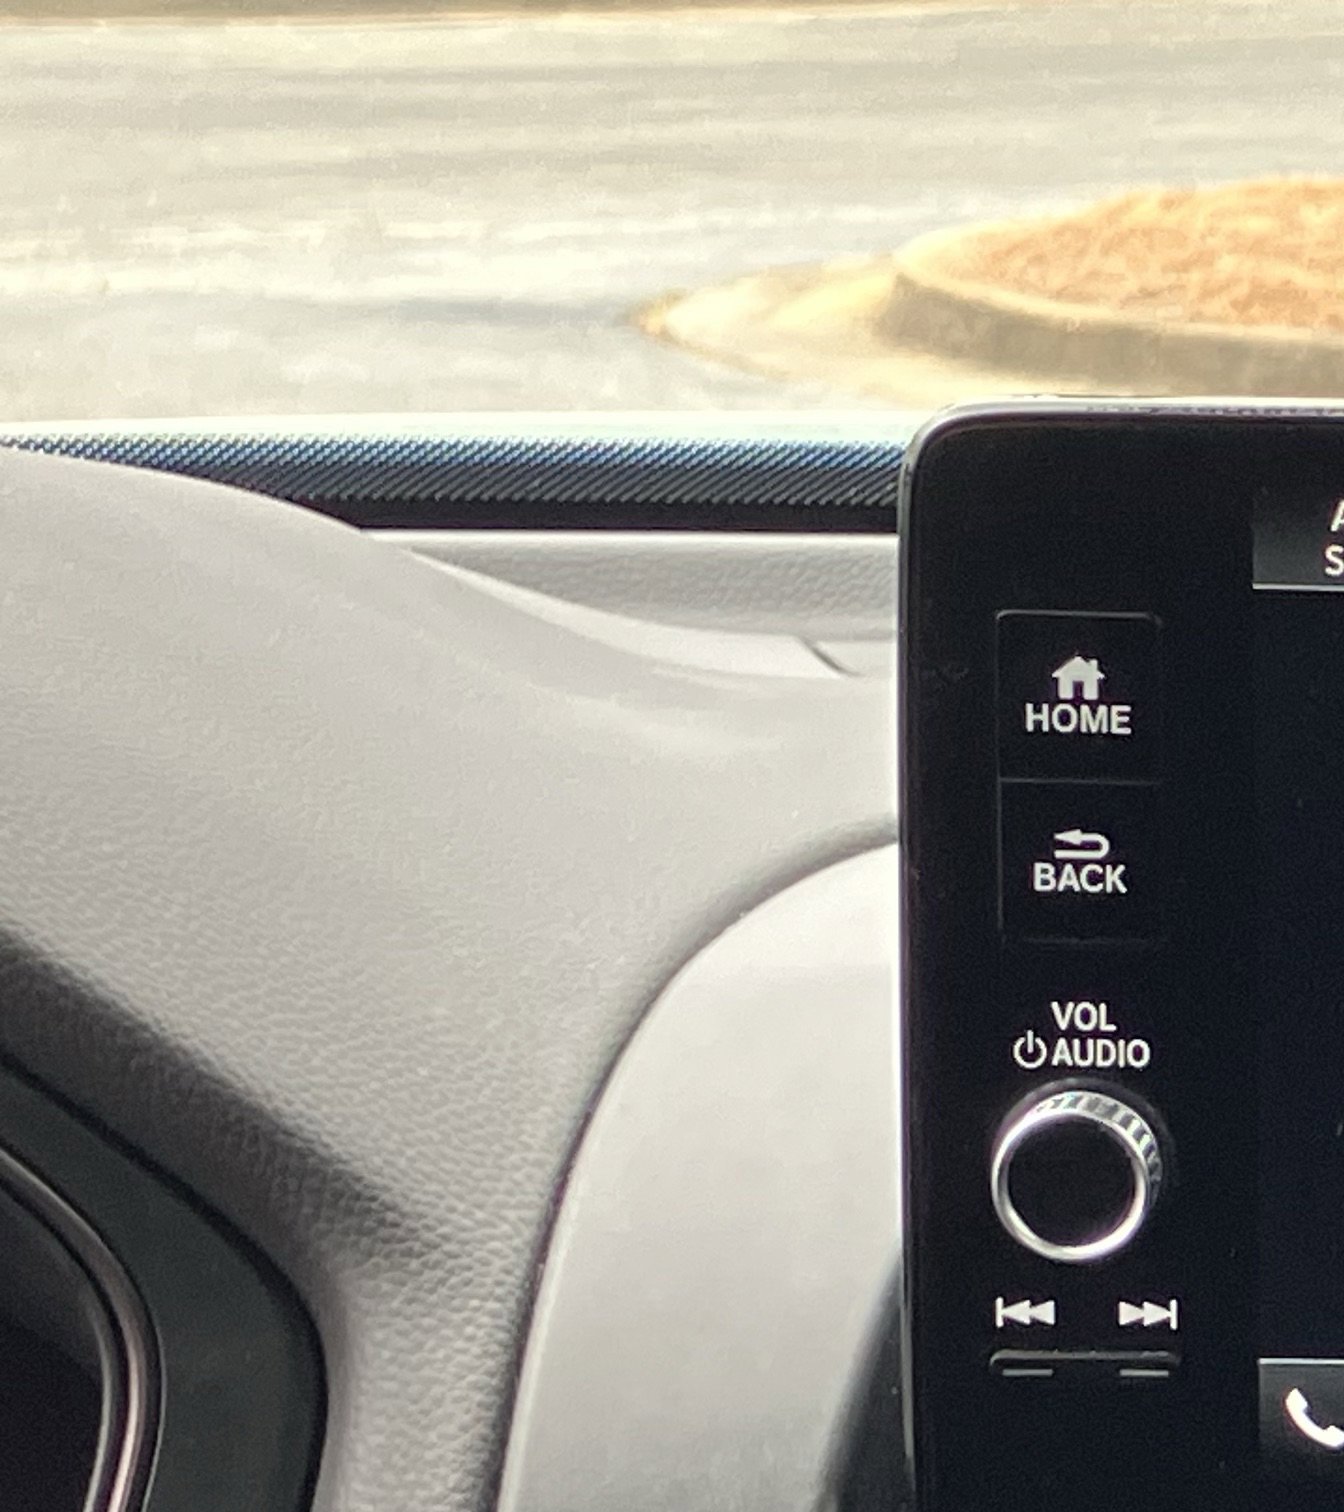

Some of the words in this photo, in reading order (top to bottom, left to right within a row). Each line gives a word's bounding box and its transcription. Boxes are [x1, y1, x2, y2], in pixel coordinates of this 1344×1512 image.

[1023, 702, 1133, 736] HOME
[1031, 861, 1128, 895] BACK
[1050, 1000, 1119, 1033] VOL
[1051, 1036, 1152, 1069] AUDIO
